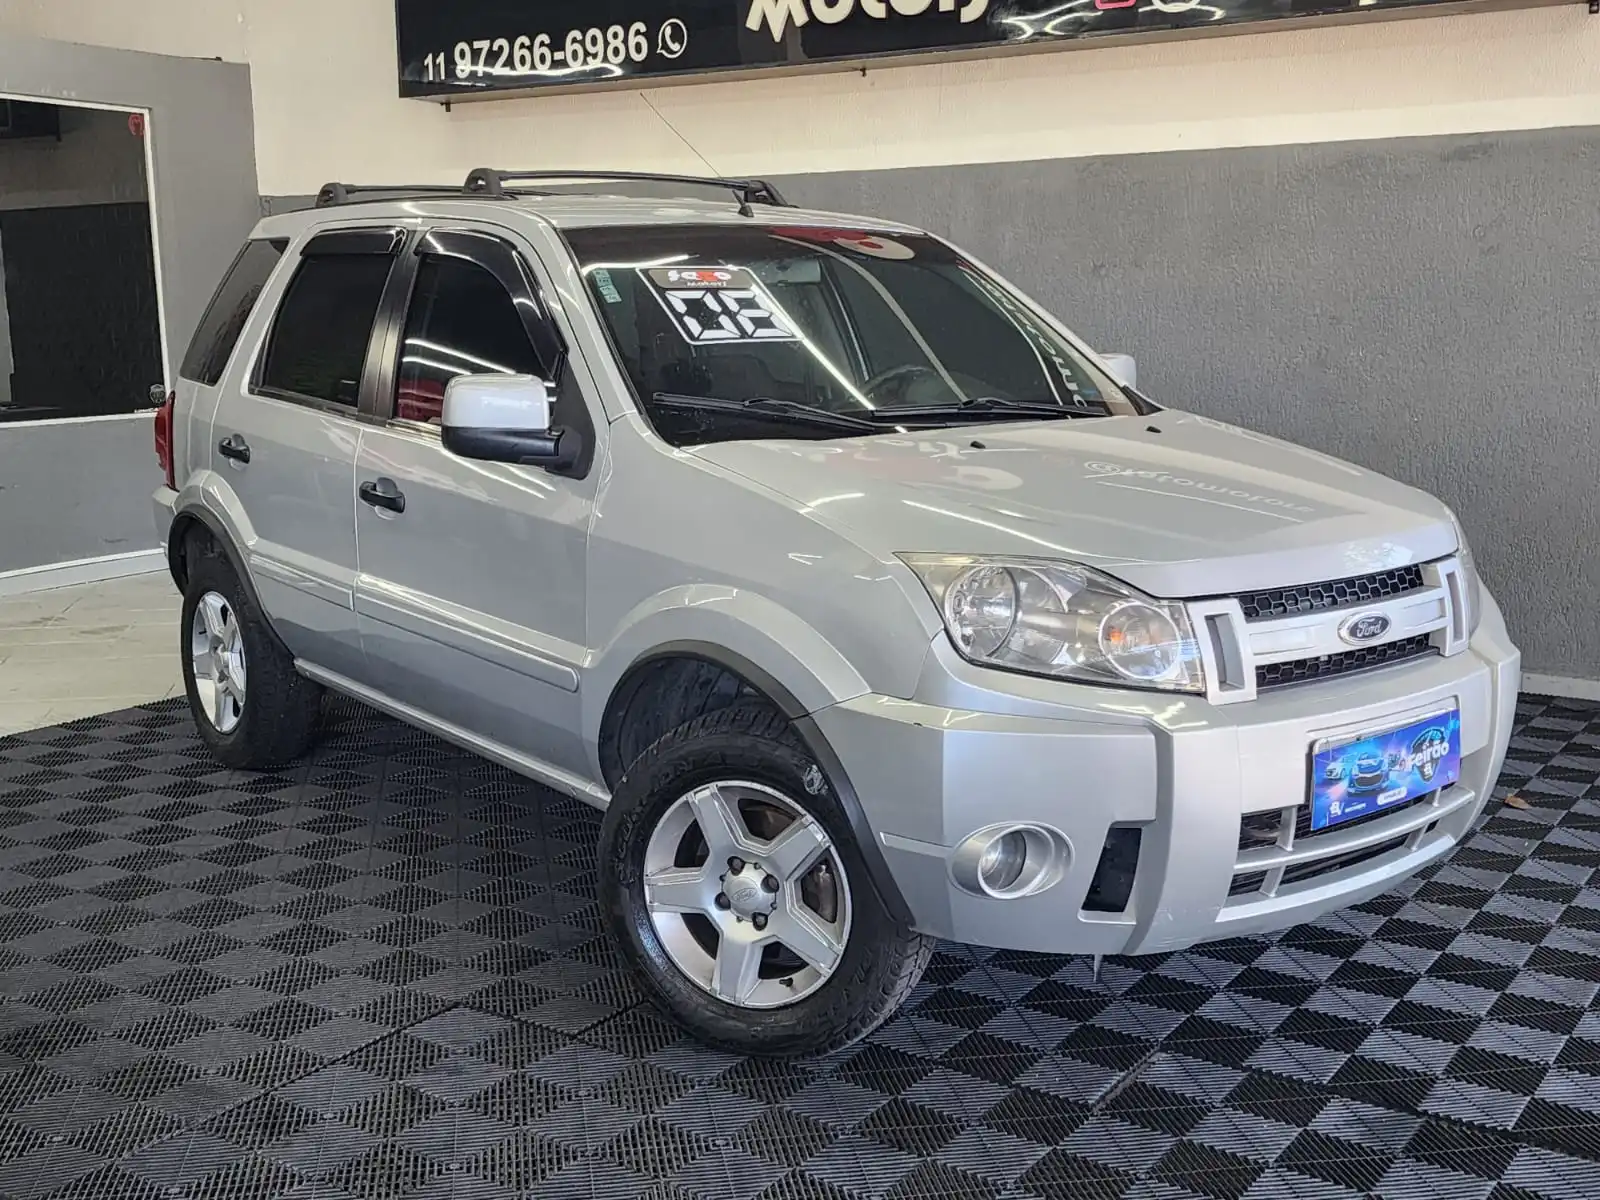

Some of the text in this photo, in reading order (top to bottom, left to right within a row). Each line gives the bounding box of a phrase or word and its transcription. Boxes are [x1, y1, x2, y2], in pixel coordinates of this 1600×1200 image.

[424, 21, 647, 81] 11 97266-6986
[1356, 618, 1382, 637] Ford
